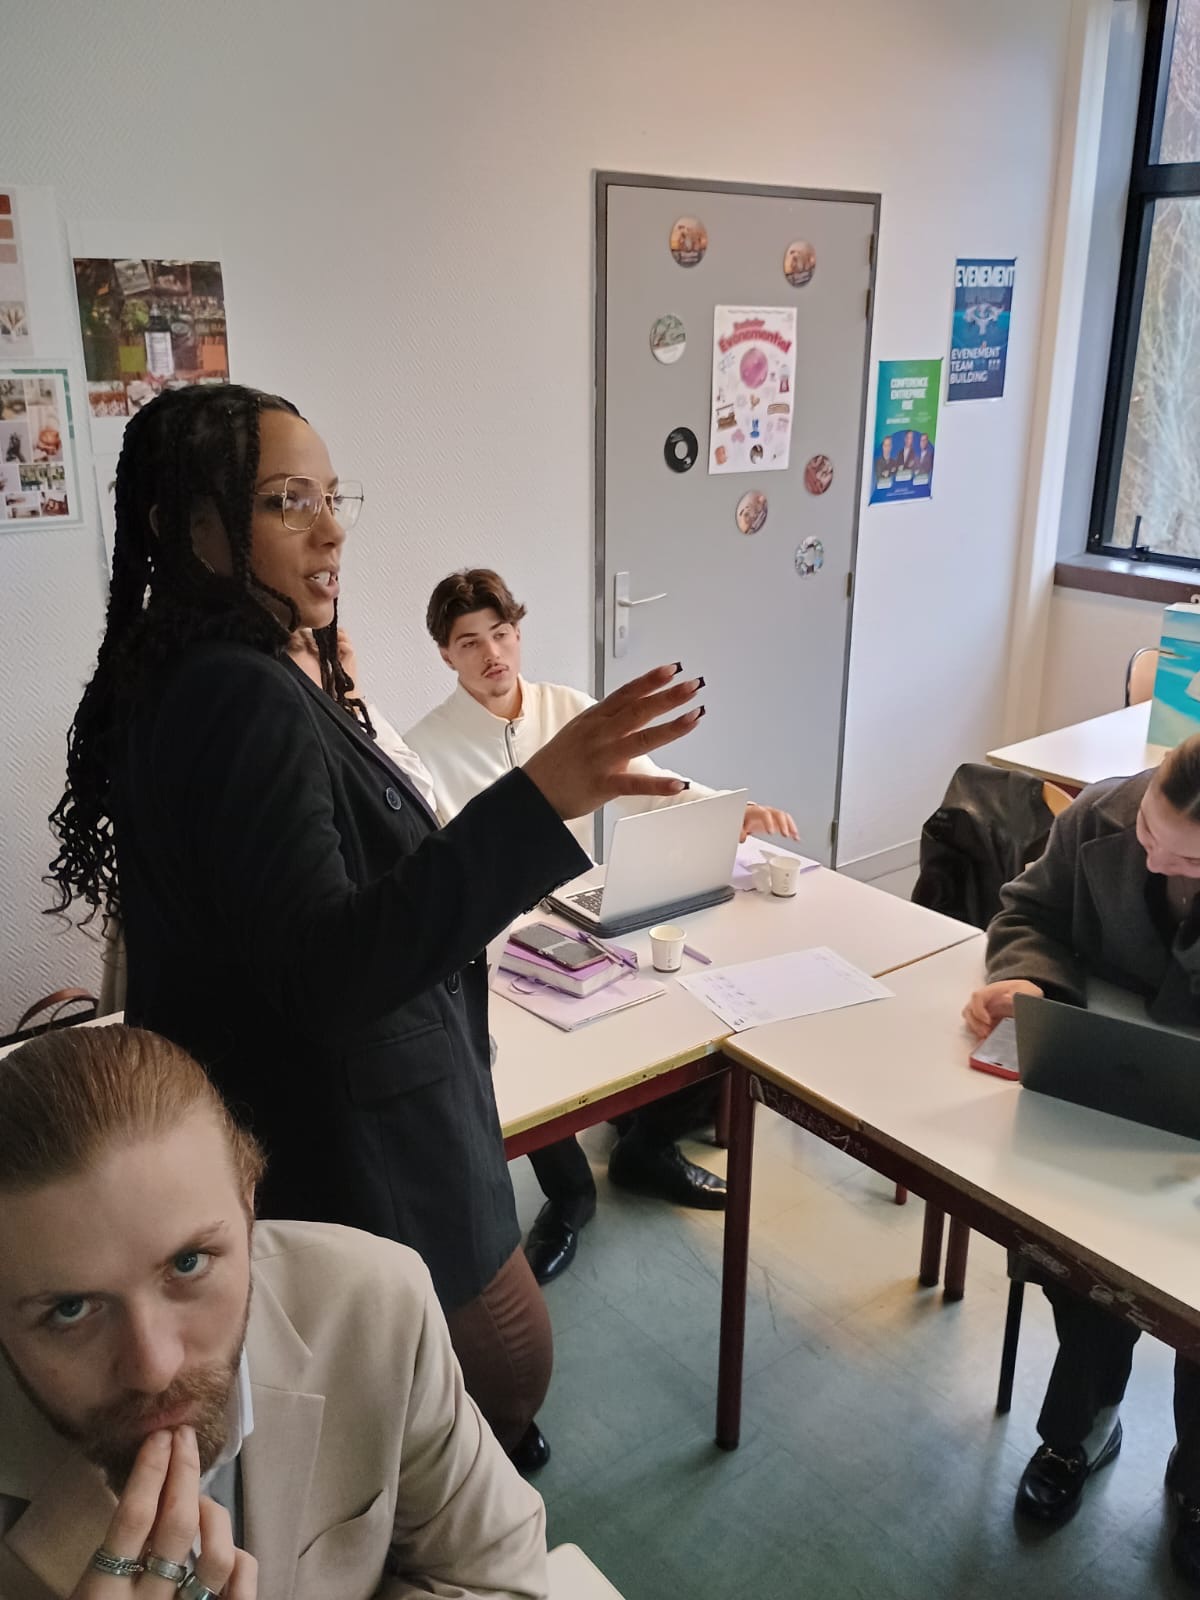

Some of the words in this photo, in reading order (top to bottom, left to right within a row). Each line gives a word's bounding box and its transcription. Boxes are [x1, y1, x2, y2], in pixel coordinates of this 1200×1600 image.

[955, 265, 1016, 288] EVENEMENT
[951, 347, 1000, 360] EVENEMENT
[951, 360, 974, 372] TEAM
[949, 371, 988, 384] BUILDING
